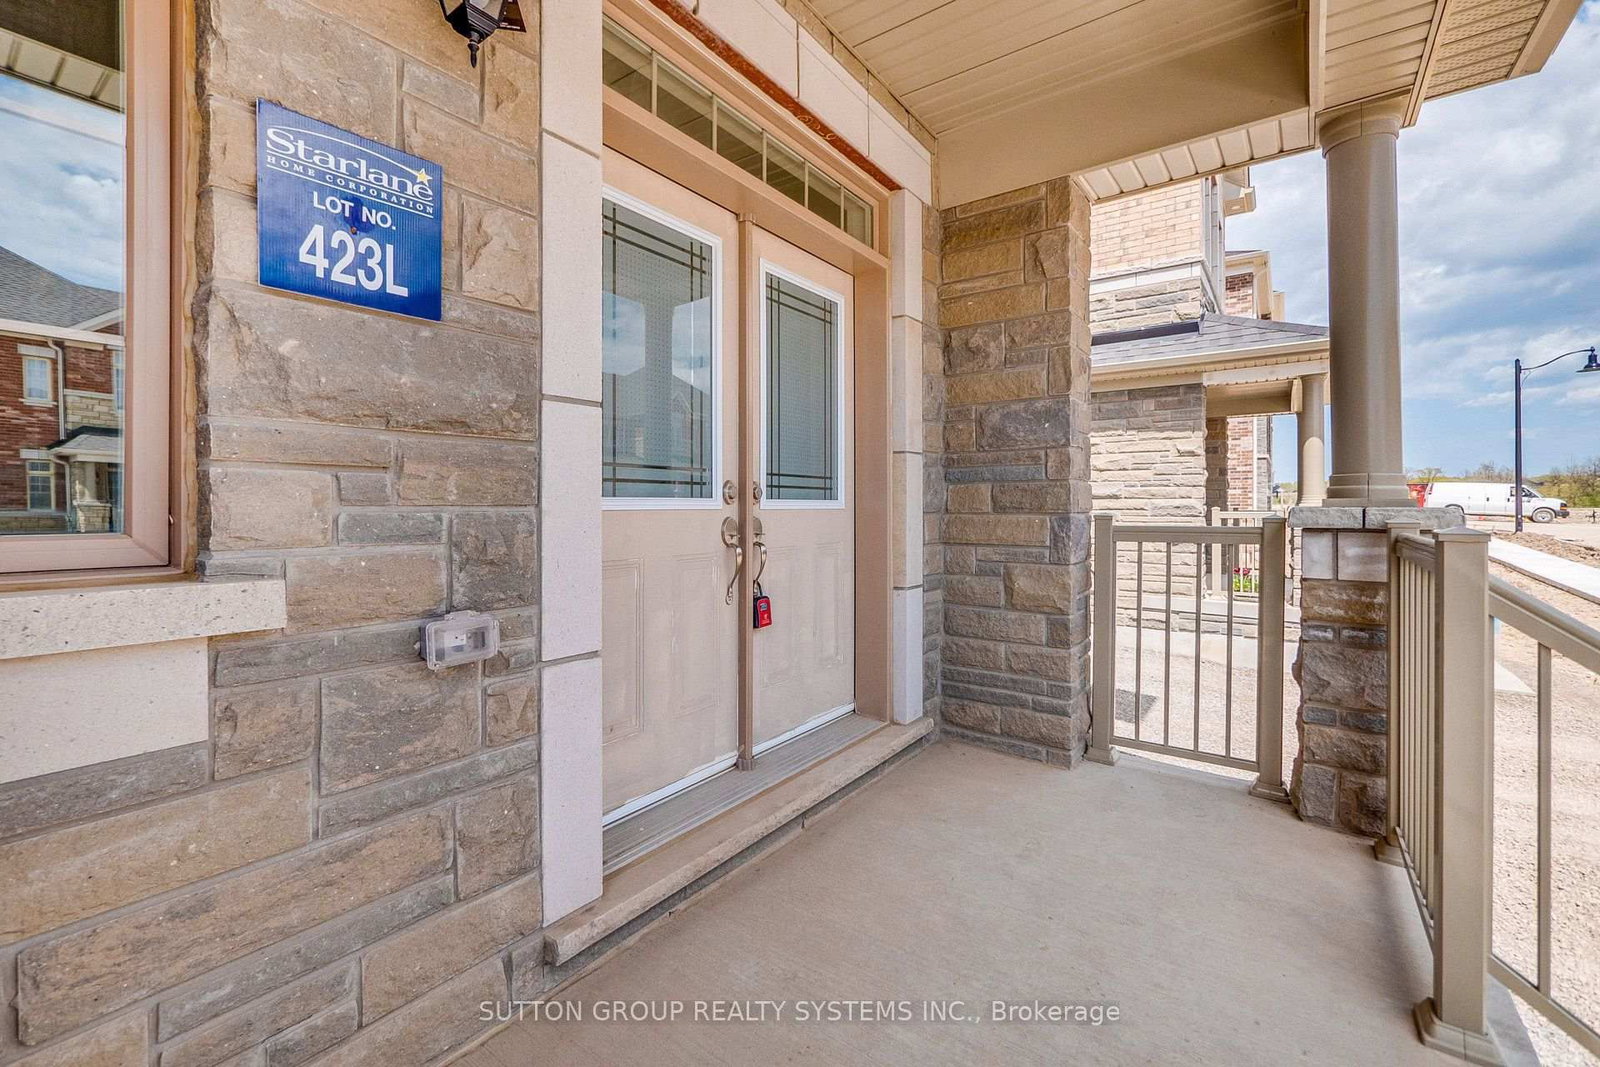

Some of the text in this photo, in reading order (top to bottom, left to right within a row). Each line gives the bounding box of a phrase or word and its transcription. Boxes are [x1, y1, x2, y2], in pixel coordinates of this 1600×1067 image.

[266, 128, 433, 201] Starlane
[267, 155, 434, 214] HOME CORPORATION
[312, 191, 396, 230] LOT NO.
[299, 224, 408, 297] 423L
